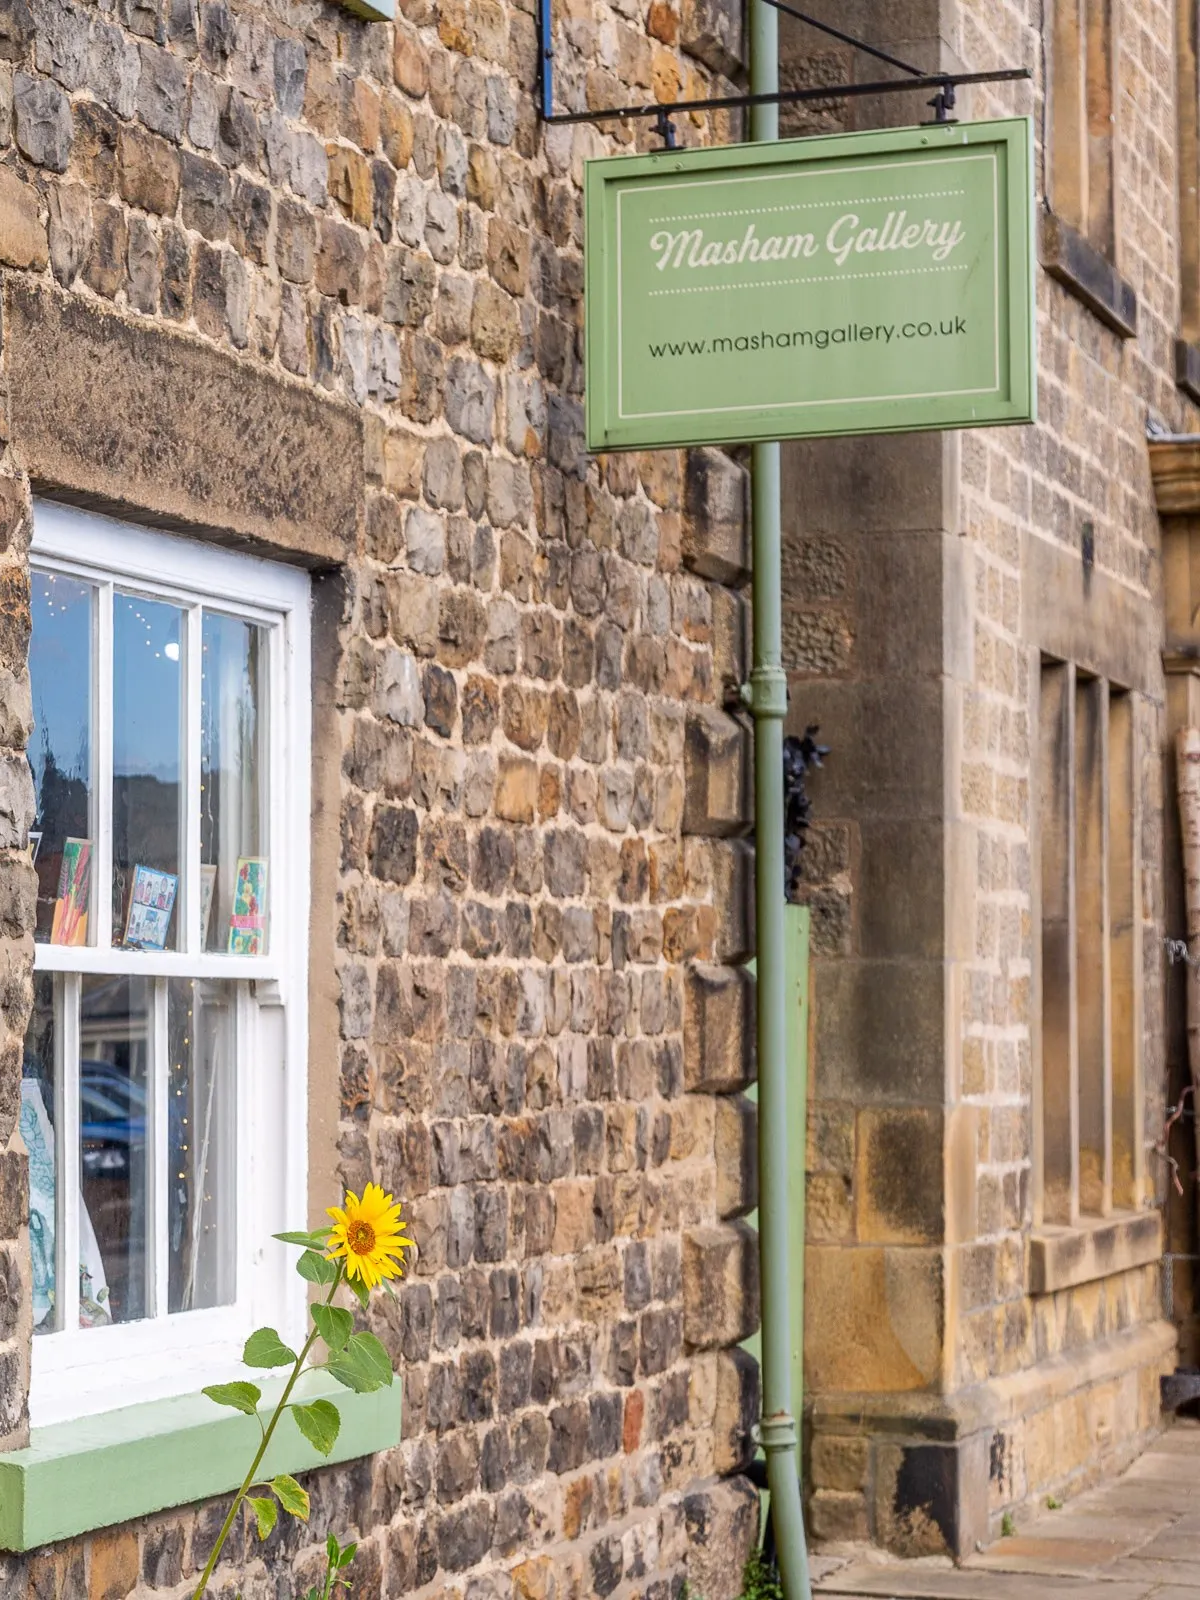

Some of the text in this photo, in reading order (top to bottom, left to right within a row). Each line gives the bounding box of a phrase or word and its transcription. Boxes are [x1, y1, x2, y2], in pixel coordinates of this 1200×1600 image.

[649, 210, 966, 271] Masham Gallery
[648, 315, 967, 358] www.mashamgallery.co.uk
